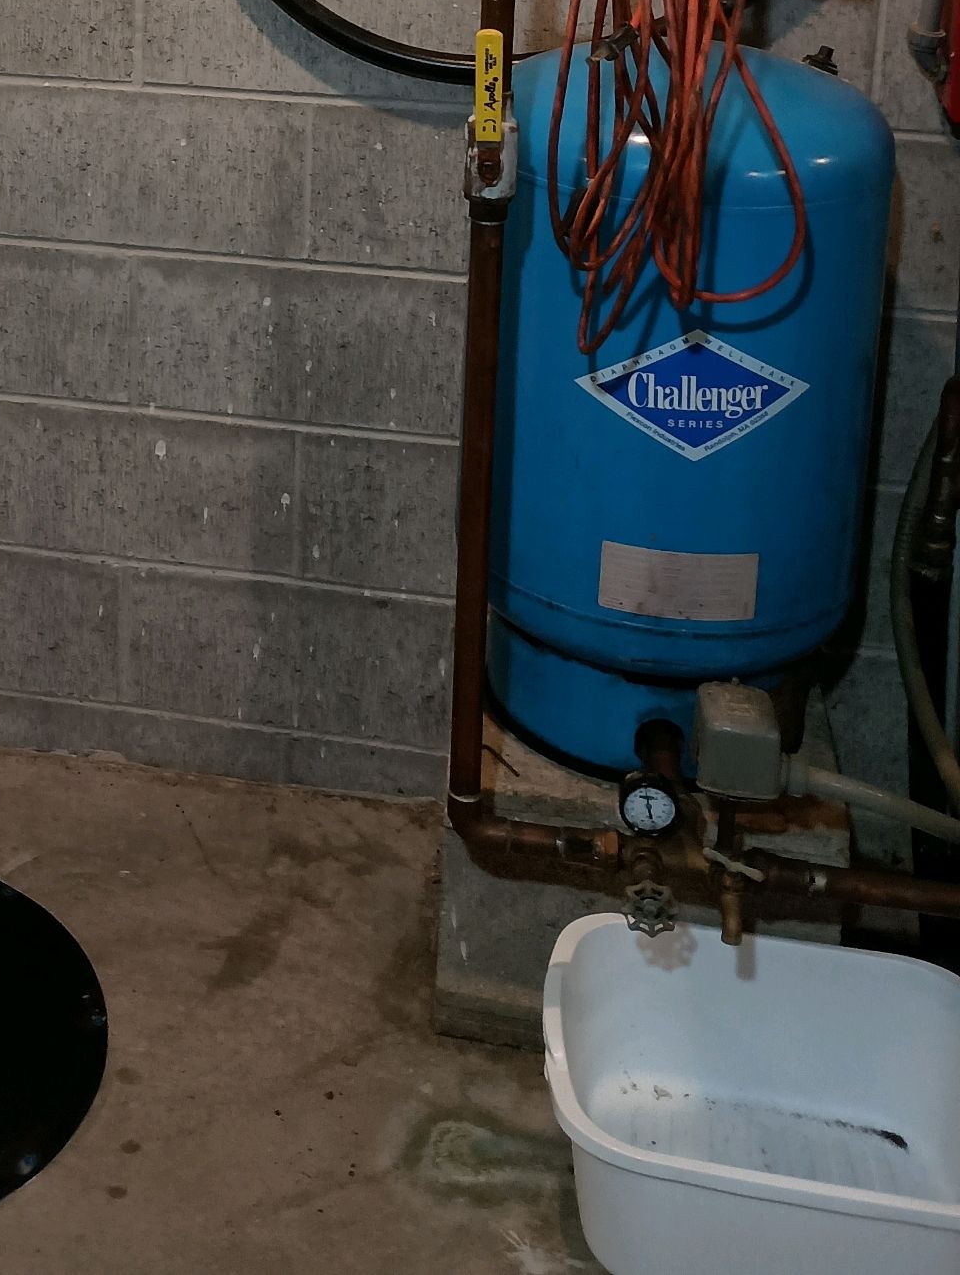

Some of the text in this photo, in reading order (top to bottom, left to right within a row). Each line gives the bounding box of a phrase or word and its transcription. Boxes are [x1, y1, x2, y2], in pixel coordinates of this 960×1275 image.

[589, 337, 796, 387] DIAPHRAGM WELL TANK
[627, 371, 769, 419] Challenger
[652, 428, 686, 452] Industries
[667, 418, 724, 429] SERIES
